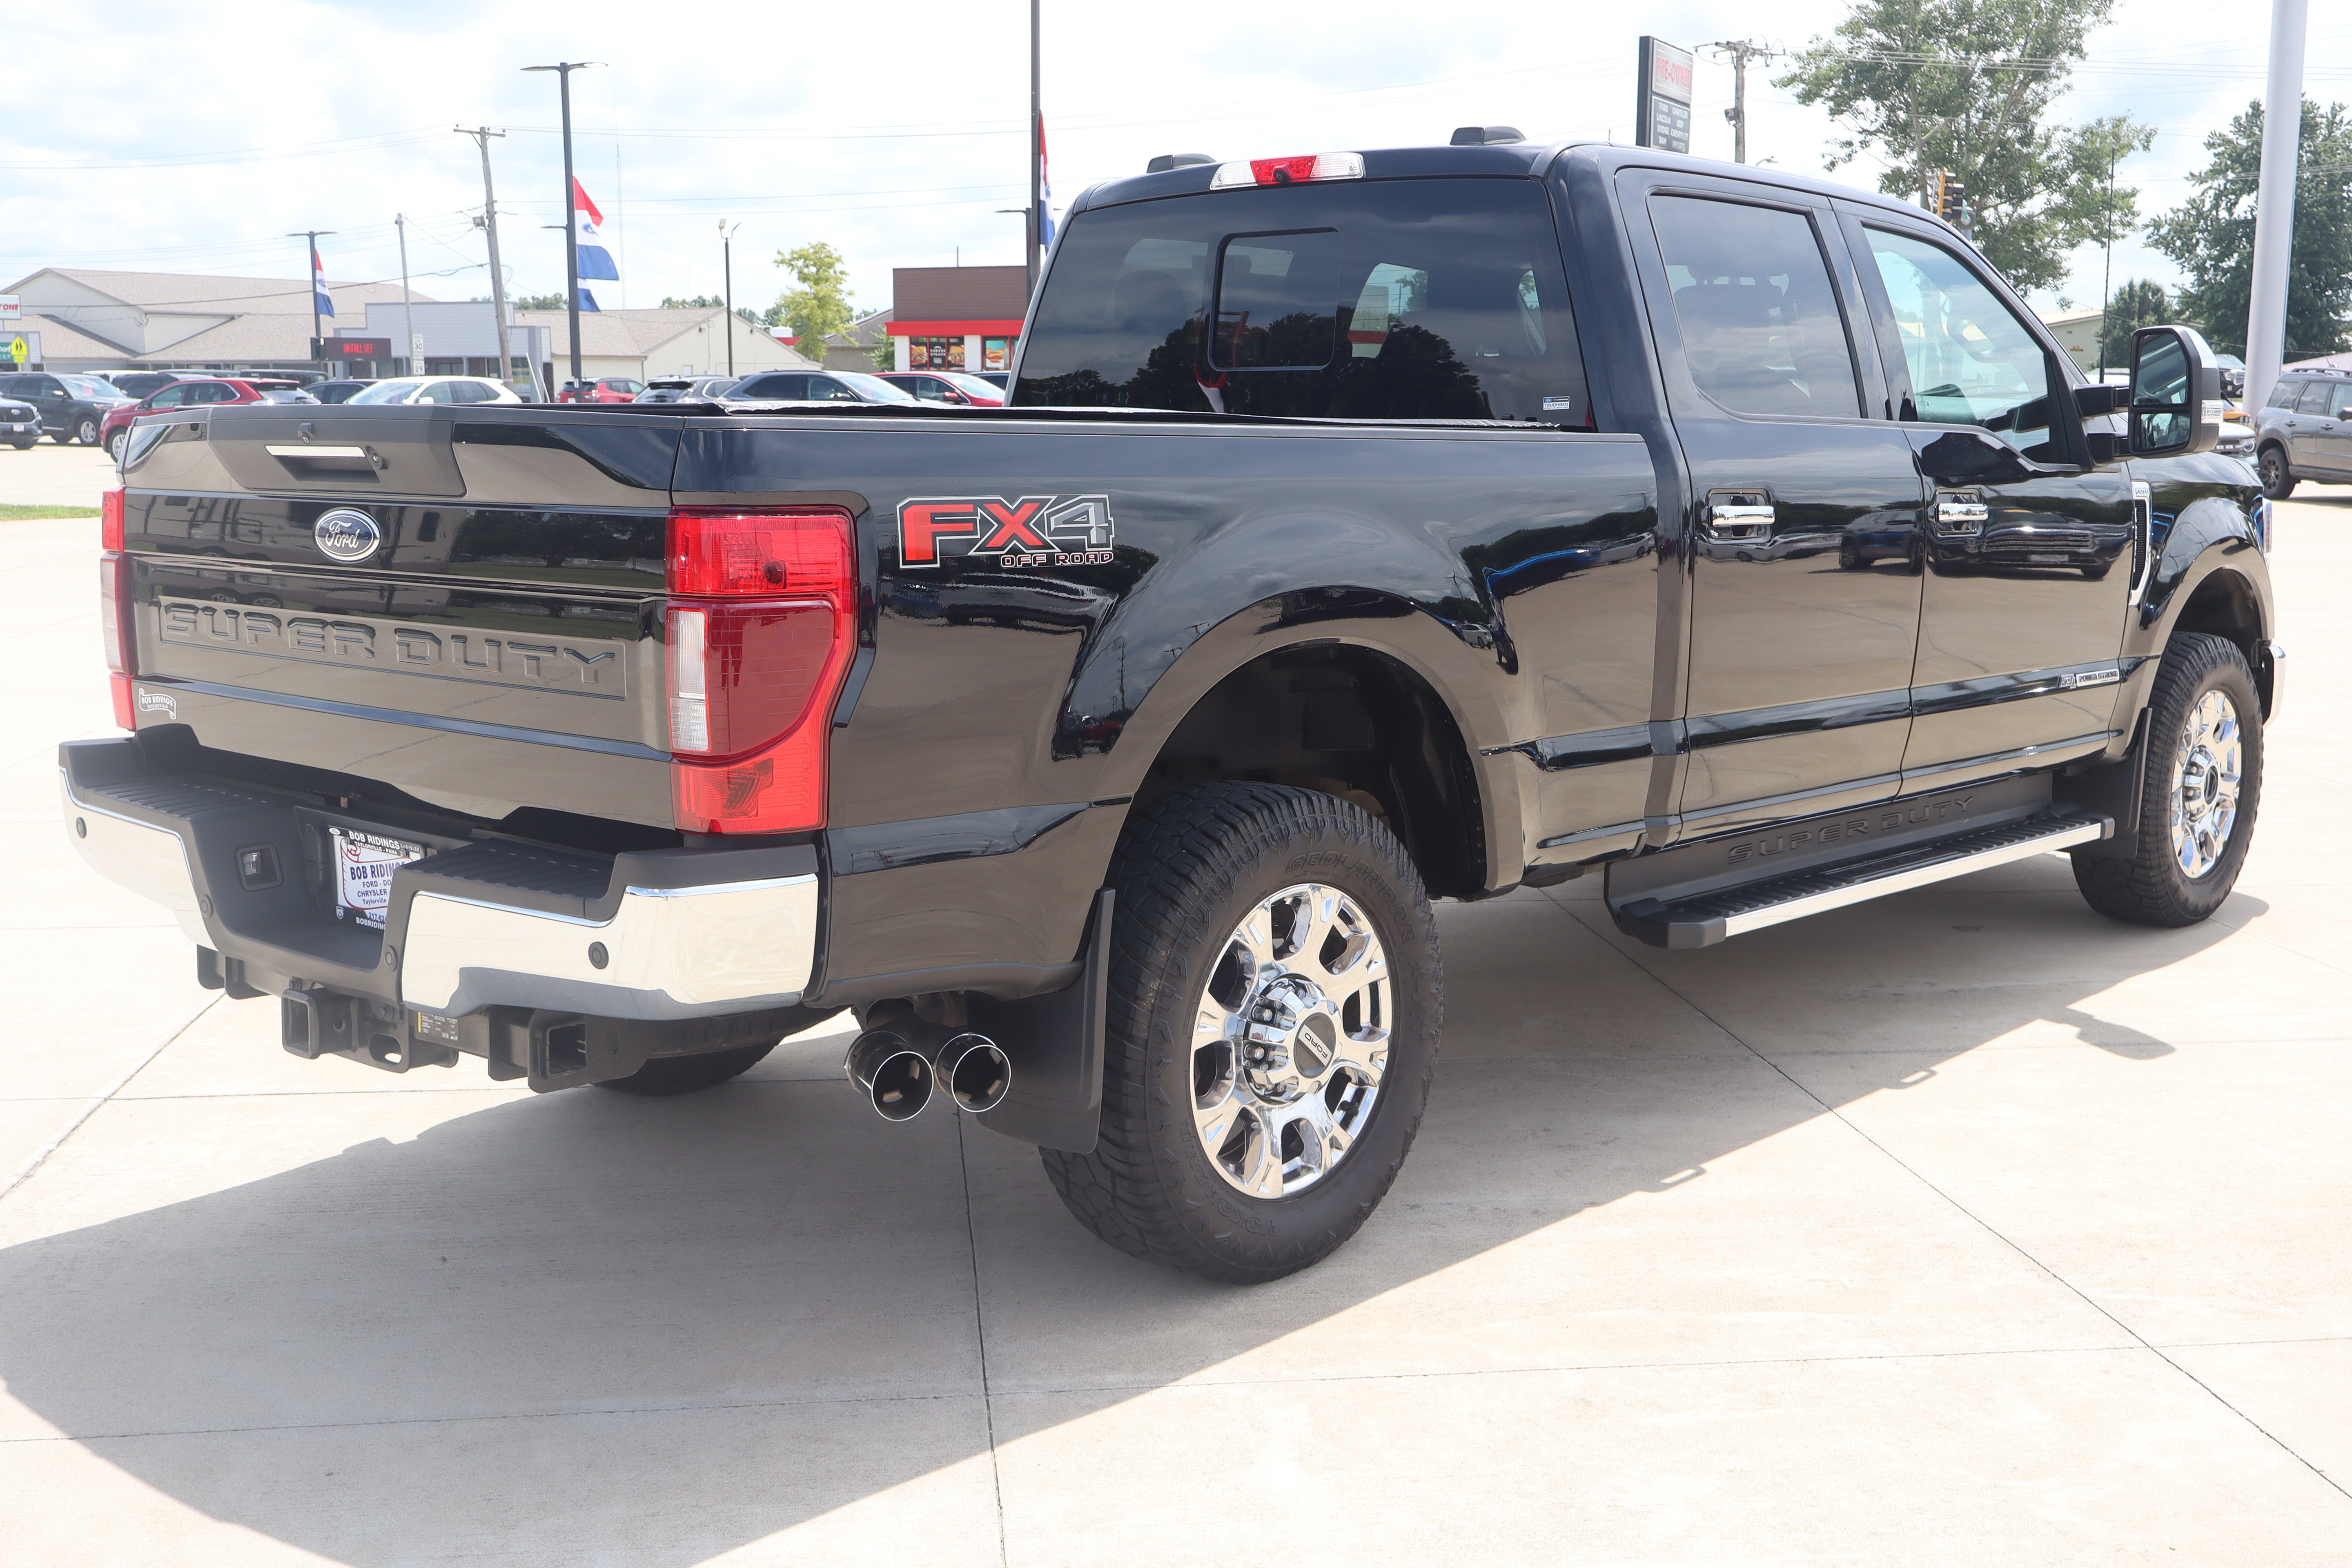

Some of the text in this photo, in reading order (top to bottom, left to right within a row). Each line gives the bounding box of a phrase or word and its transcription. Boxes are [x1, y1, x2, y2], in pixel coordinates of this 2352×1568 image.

[1657, 56, 1691, 89] PRE-OWNED
[1656, 112, 1671, 124] LINCOLN
[1659, 102, 1688, 119] FORD CHRYSLER
[1657, 124, 1688, 140] DODGE CHEVROLET
[1659, 136, 1667, 145] RAM
[343, 343, 373, 353] ON FULL SET
[325, 520, 360, 548] Ford
[897, 494, 1114, 568] FX4
[1000, 551, 1114, 568] OFF ROAD
[164, 602, 616, 685] SUPER DUTY
[152, 695, 173, 707] RIDINGS
[1728, 795, 1974, 865] SUPER DUTY
[348, 831, 420, 852] BOB RIDINGS CHRYSLER
[354, 841, 383, 852] TAYLORVILLE
[350, 865, 368, 881] BOB
[357, 889, 388, 898] CHRYSLER
[1286, 851, 1416, 945] GEOLANDAR
[369, 912, 387, 922] 217-82
[1304, 1032, 1328, 1058] FORD
